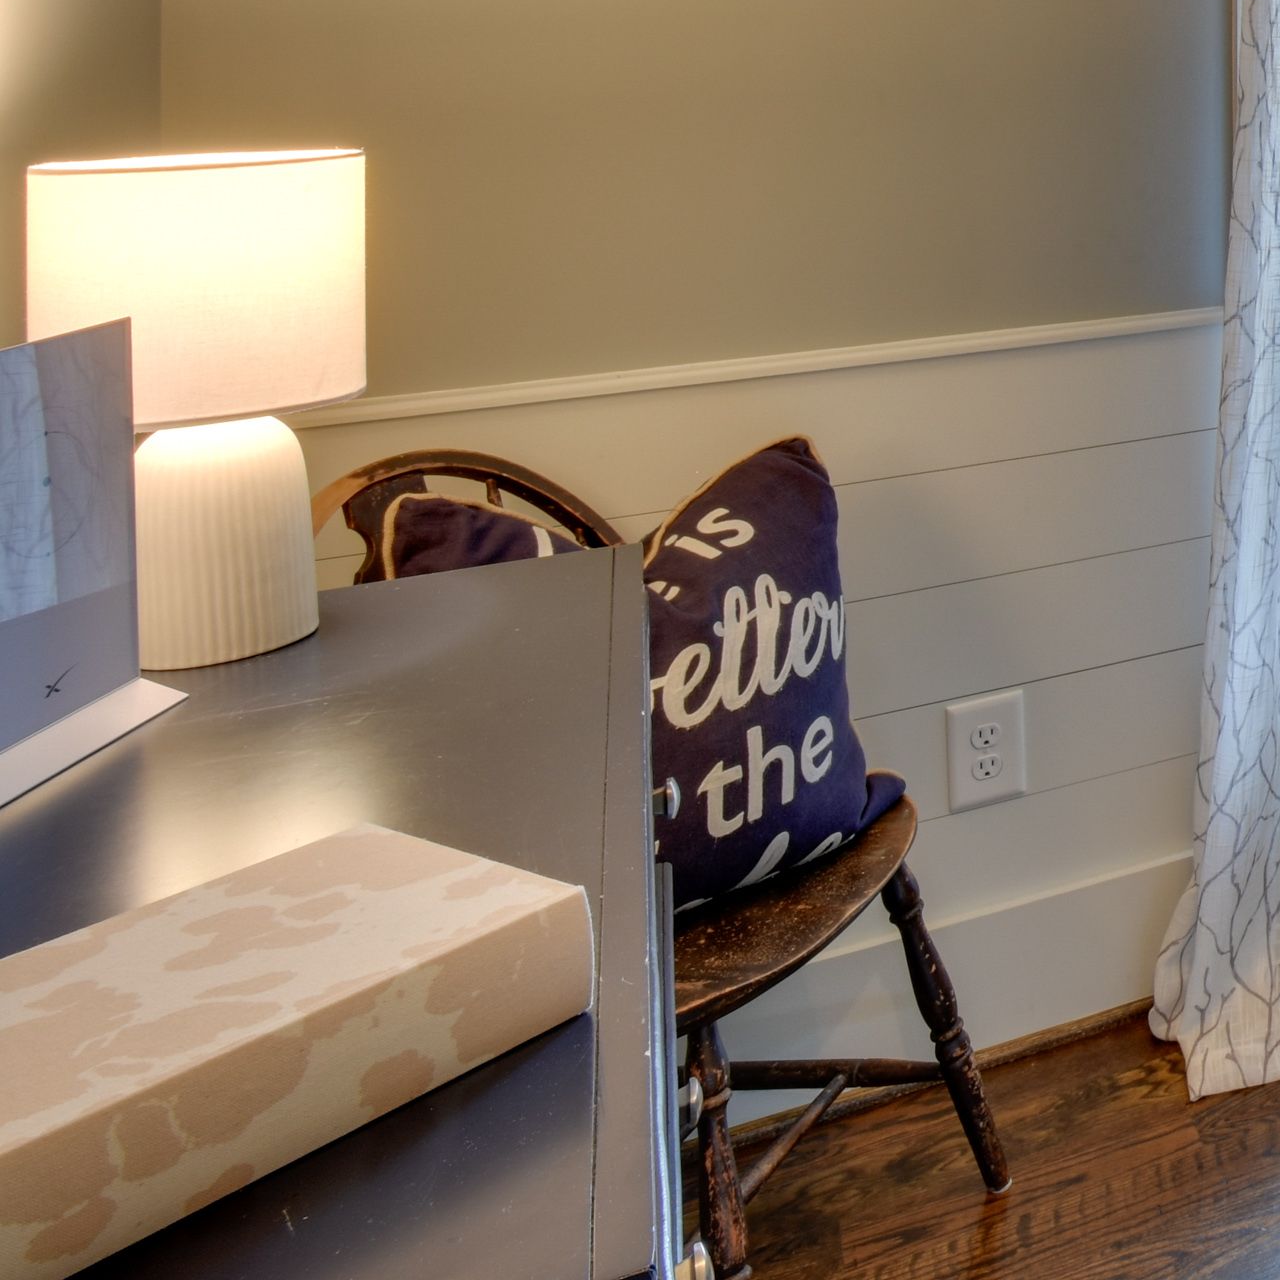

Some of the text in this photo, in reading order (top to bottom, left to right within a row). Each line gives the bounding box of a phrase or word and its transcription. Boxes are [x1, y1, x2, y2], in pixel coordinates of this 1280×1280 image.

[664, 507, 756, 560] is
[651, 572, 846, 728] etter
[697, 715, 834, 838] the
